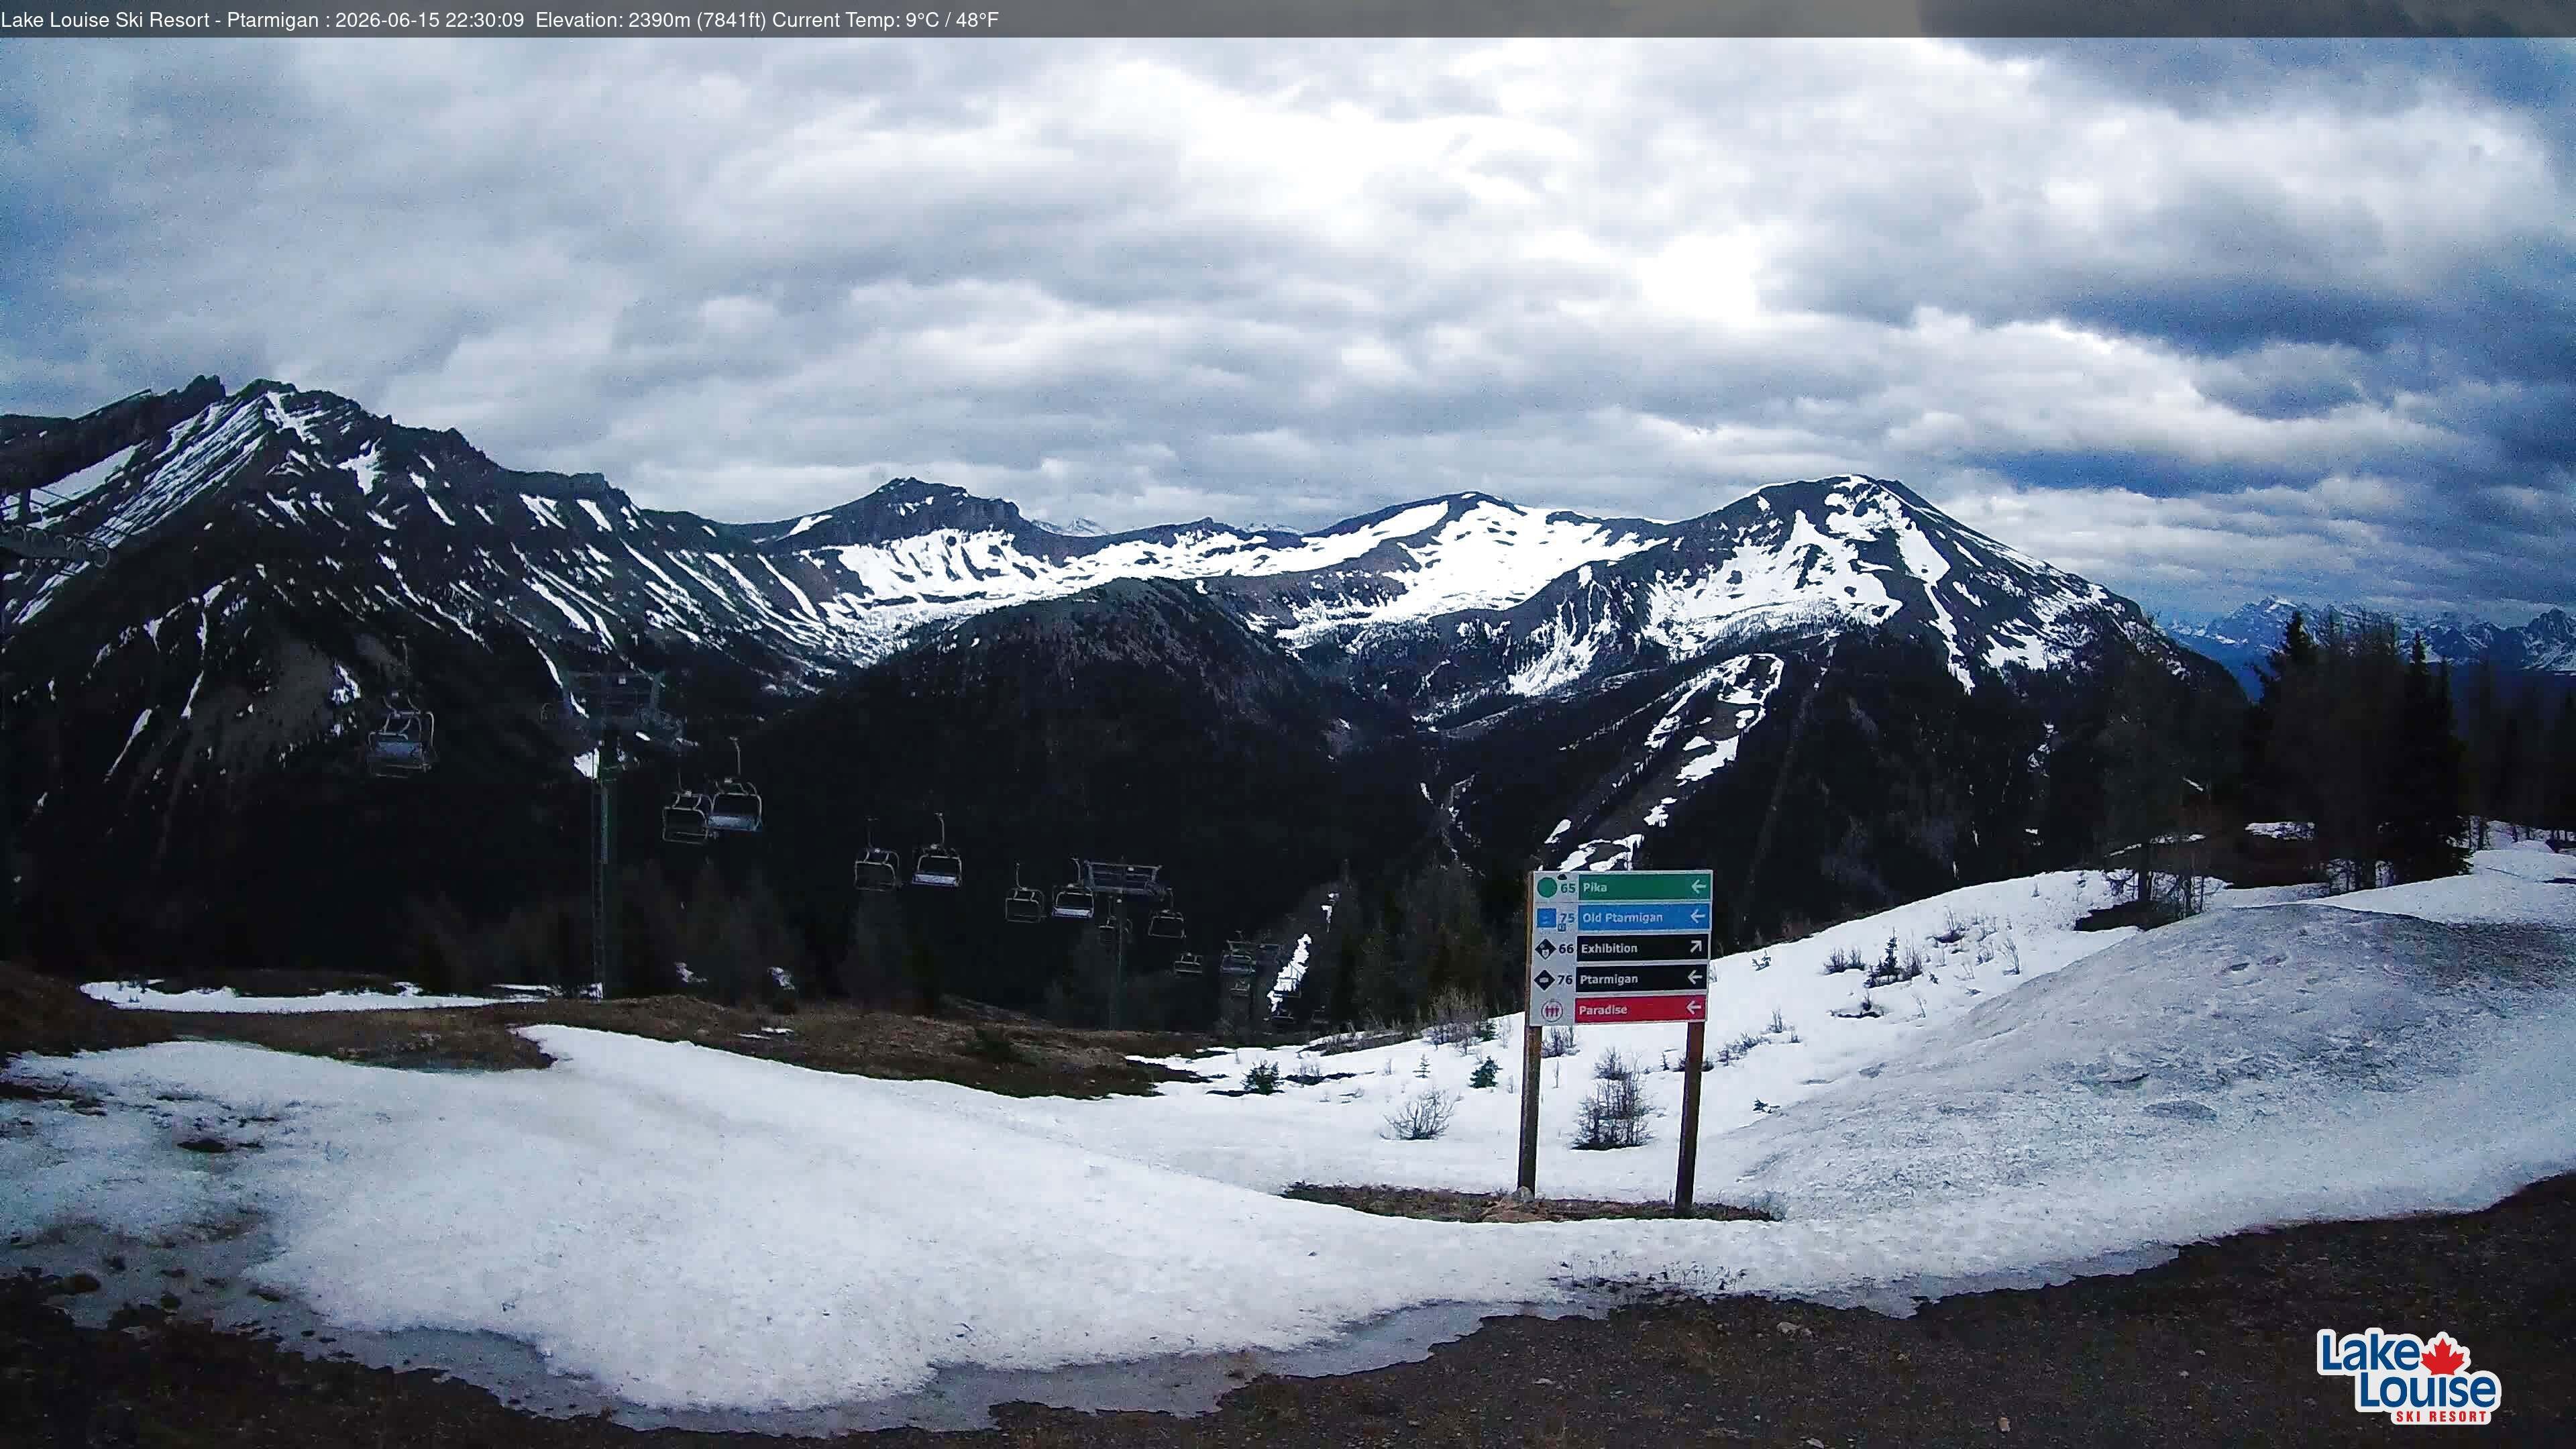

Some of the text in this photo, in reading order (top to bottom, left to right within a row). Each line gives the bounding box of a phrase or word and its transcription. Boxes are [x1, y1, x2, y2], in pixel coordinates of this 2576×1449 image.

[1560, 882, 1607, 894] 65 Pika
[1559, 912, 1664, 924] 75 Old Ptarmigan
[1558, 943, 1638, 954] 66 Exhibition
[1557, 974, 1638, 985] 76 Ptarmigan
[1579, 1005, 1628, 1016] Paradise
